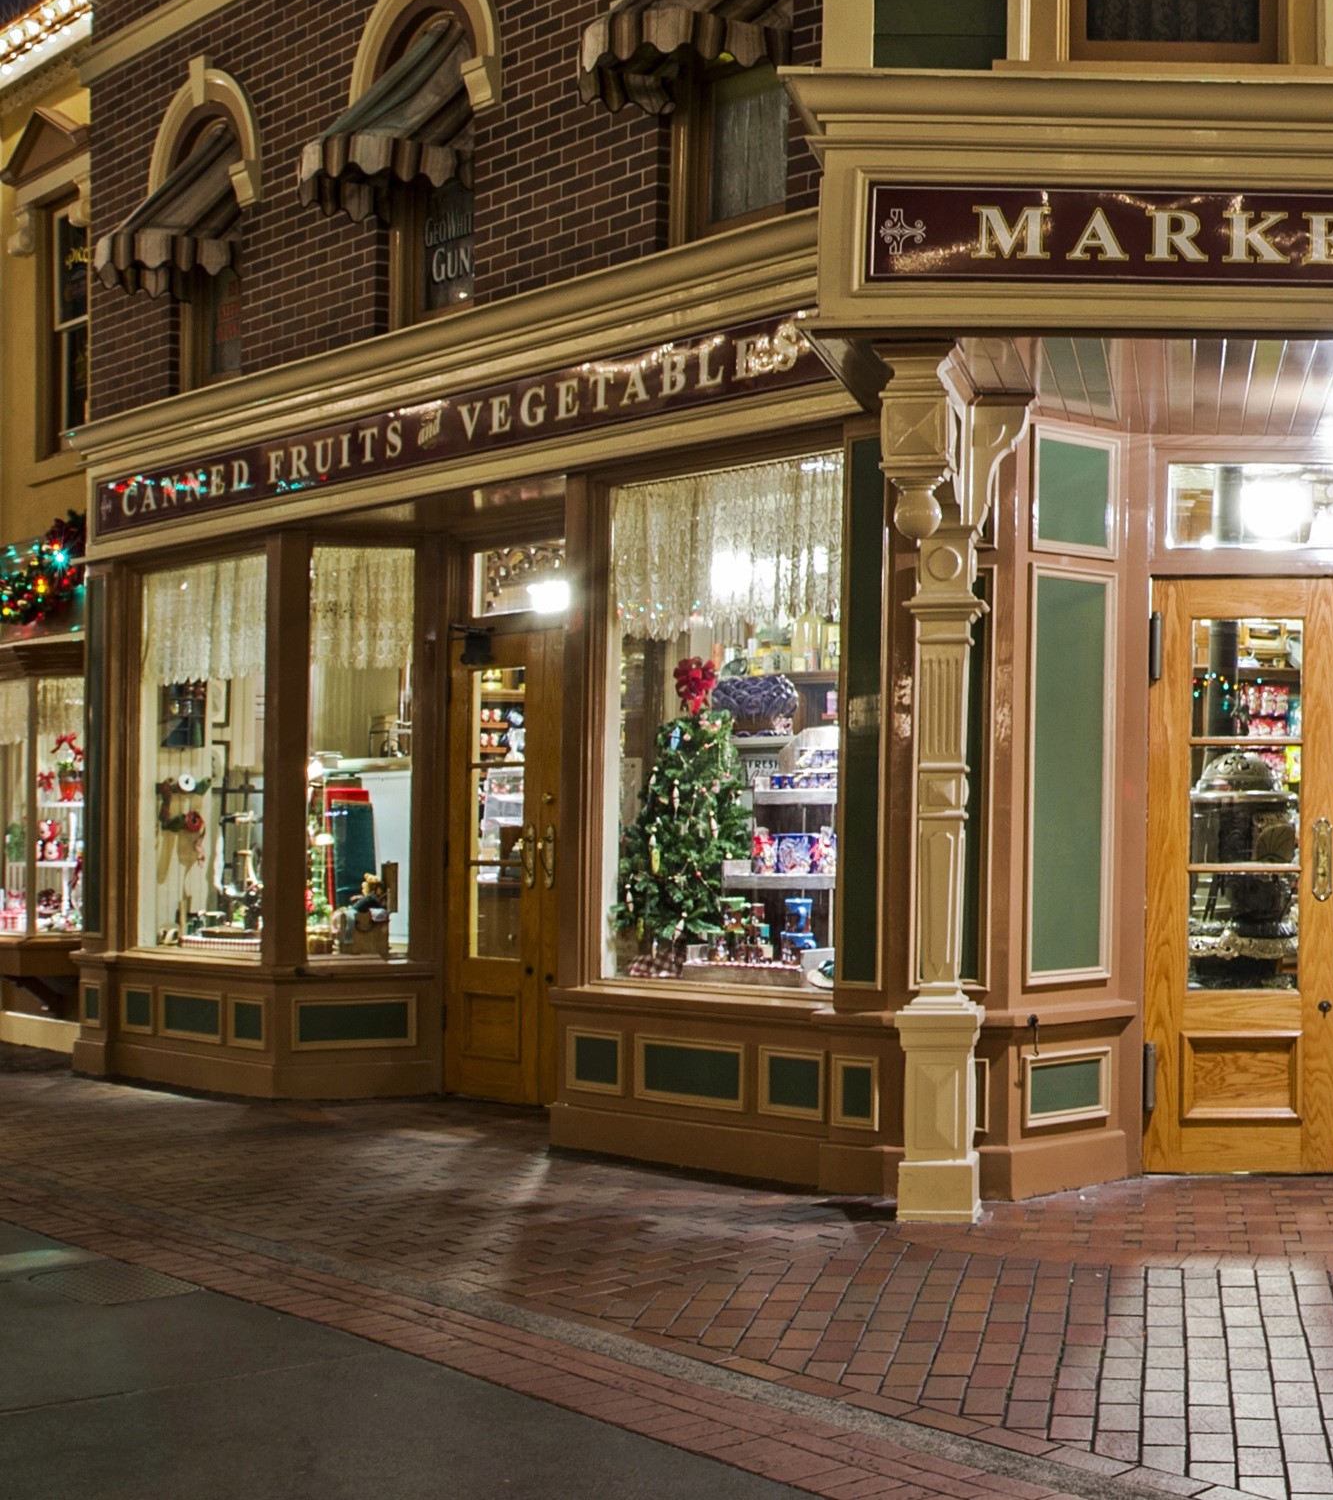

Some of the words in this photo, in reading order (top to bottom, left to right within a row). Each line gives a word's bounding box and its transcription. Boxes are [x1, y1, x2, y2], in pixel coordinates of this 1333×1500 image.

[121, 460, 250, 517] CANNED
[267, 419, 404, 485] FRUITS
[459, 321, 799, 442] VEGETABLES
